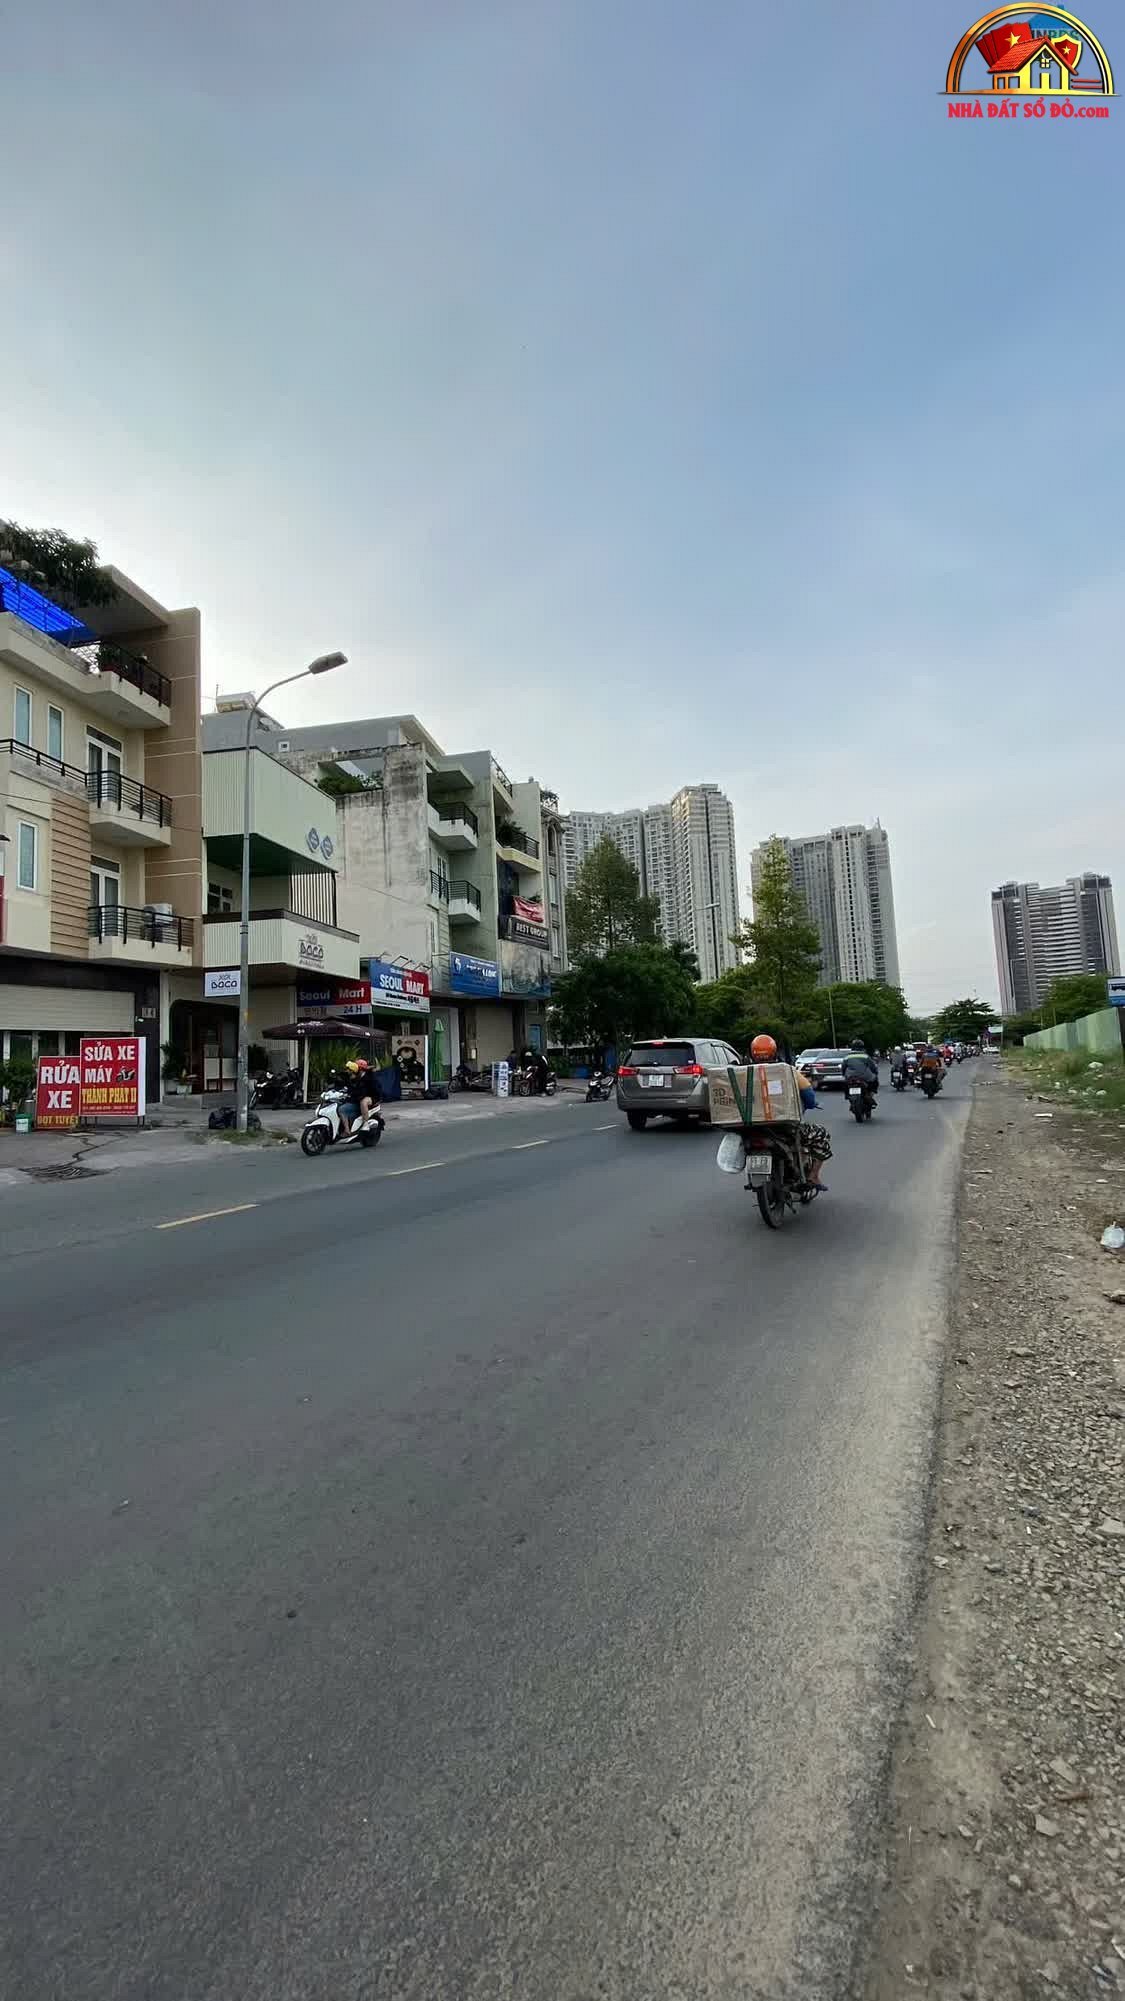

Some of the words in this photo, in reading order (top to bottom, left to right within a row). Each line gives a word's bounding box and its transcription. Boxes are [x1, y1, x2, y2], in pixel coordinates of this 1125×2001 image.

[379, 974, 404, 991] SEOUL
[406, 980, 424, 995] MART
[299, 989, 331, 1001] Seoul
[339, 988, 365, 999] Mart
[84, 1041, 113, 1061] SỬA
[117, 1045, 135, 1061] XE
[40, 1060, 80, 1084] RỬA
[84, 1065, 113, 1083] MÁY
[47, 1090, 73, 1109] XE
